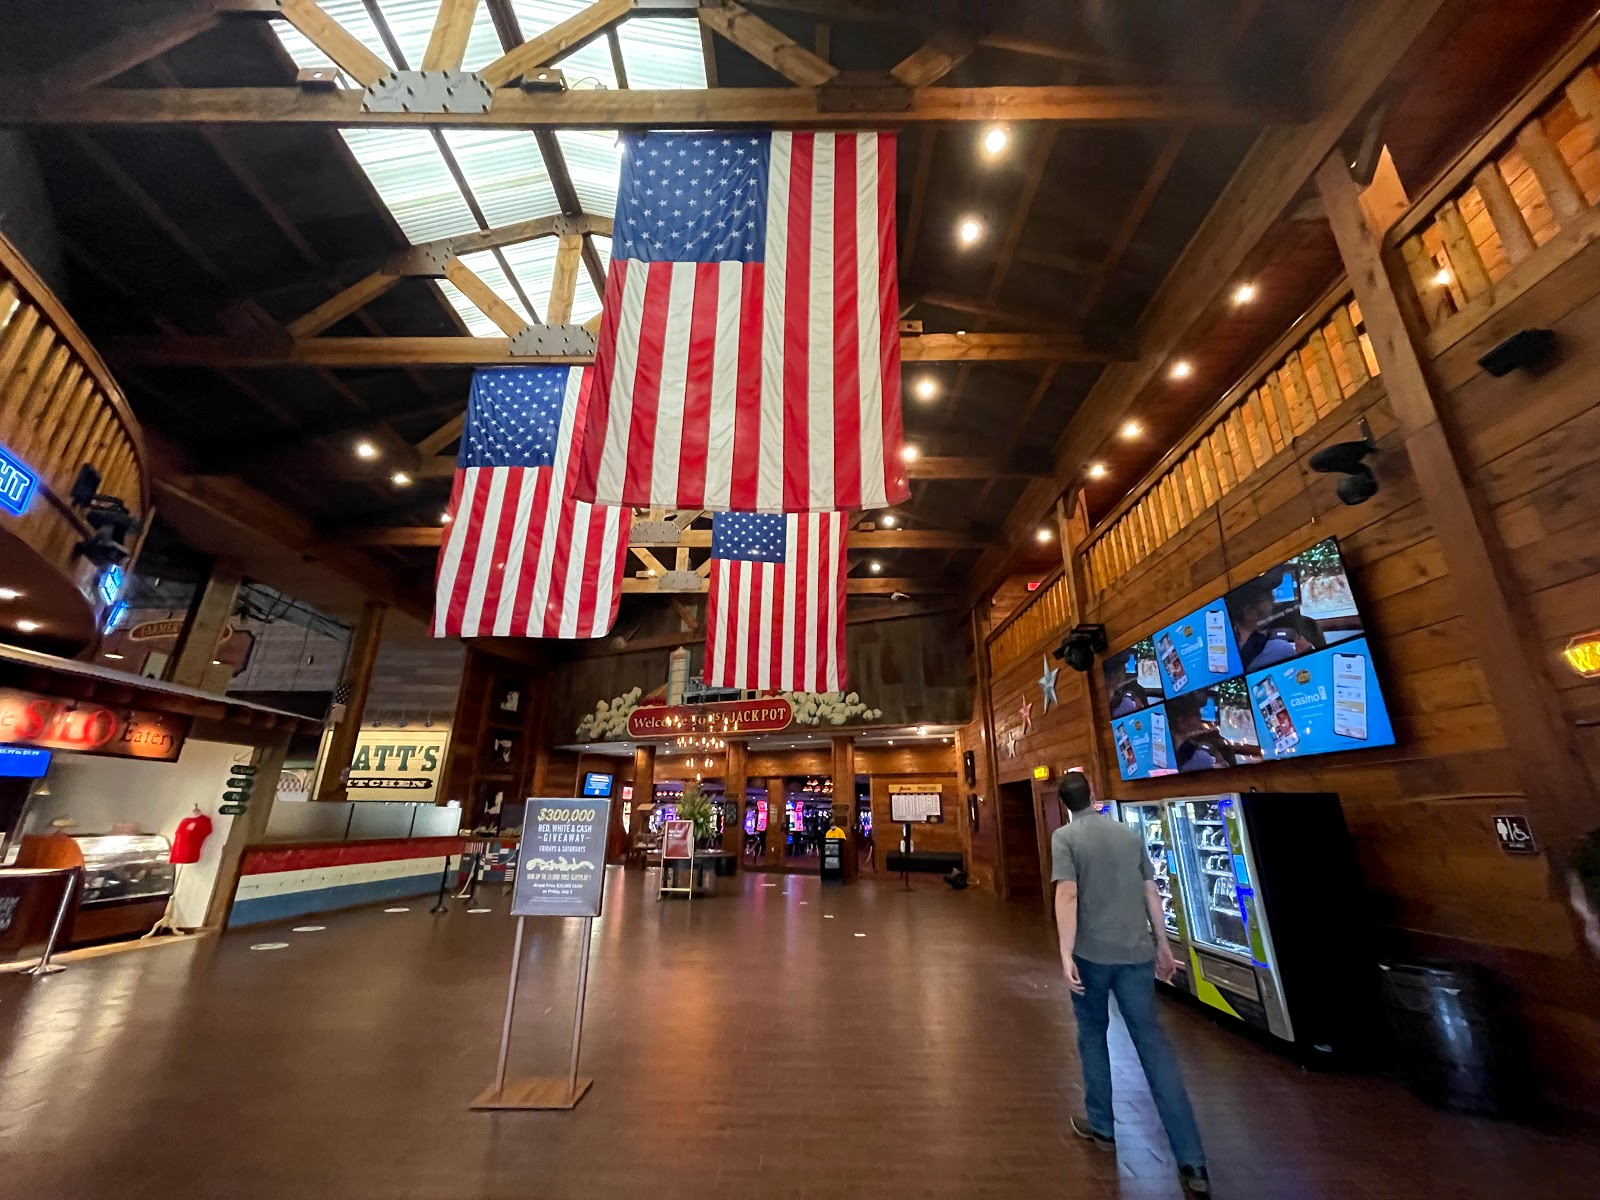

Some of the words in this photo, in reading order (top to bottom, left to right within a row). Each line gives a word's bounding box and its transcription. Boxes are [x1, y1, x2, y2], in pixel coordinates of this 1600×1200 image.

[1290, 693, 1320, 707] casino
[14, 700, 118, 746] SILO
[729, 708, 787, 723] JACKPOT
[351, 744, 440, 771] ATT'S
[538, 808, 596, 823] $300,000
[538, 824, 551, 833] RED,
[552, 824, 570, 832] WHITE
[576, 825, 592, 833] CASH
[562, 845, 586, 853] SATURDAYS
